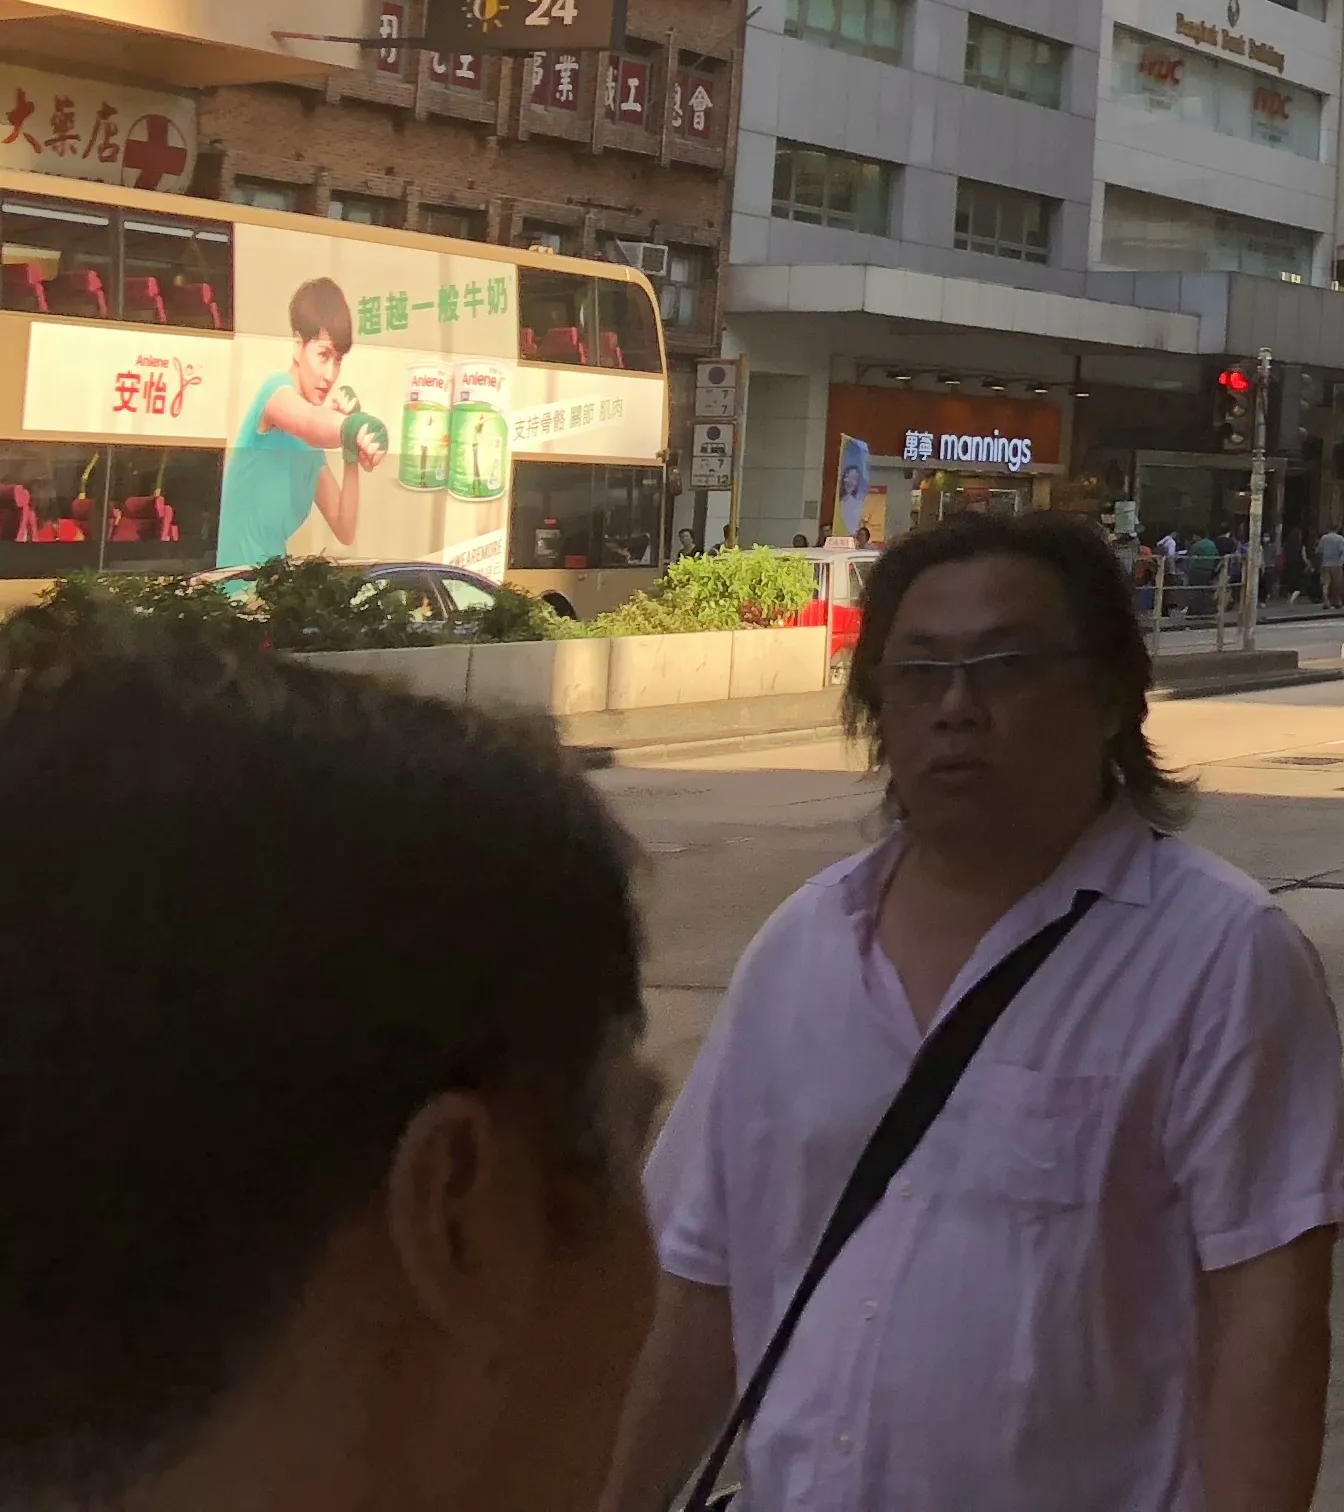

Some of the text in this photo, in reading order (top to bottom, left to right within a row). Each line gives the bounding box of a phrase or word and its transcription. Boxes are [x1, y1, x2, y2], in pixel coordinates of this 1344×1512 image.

[357, 276, 509, 336] 超越一般牛奶
[136, 355, 169, 368] Anlene
[112, 370, 168, 415] 安怡
[411, 374, 445, 389] Anlene
[462, 372, 497, 387] Anlene
[939, 428, 1032, 472] mannings
